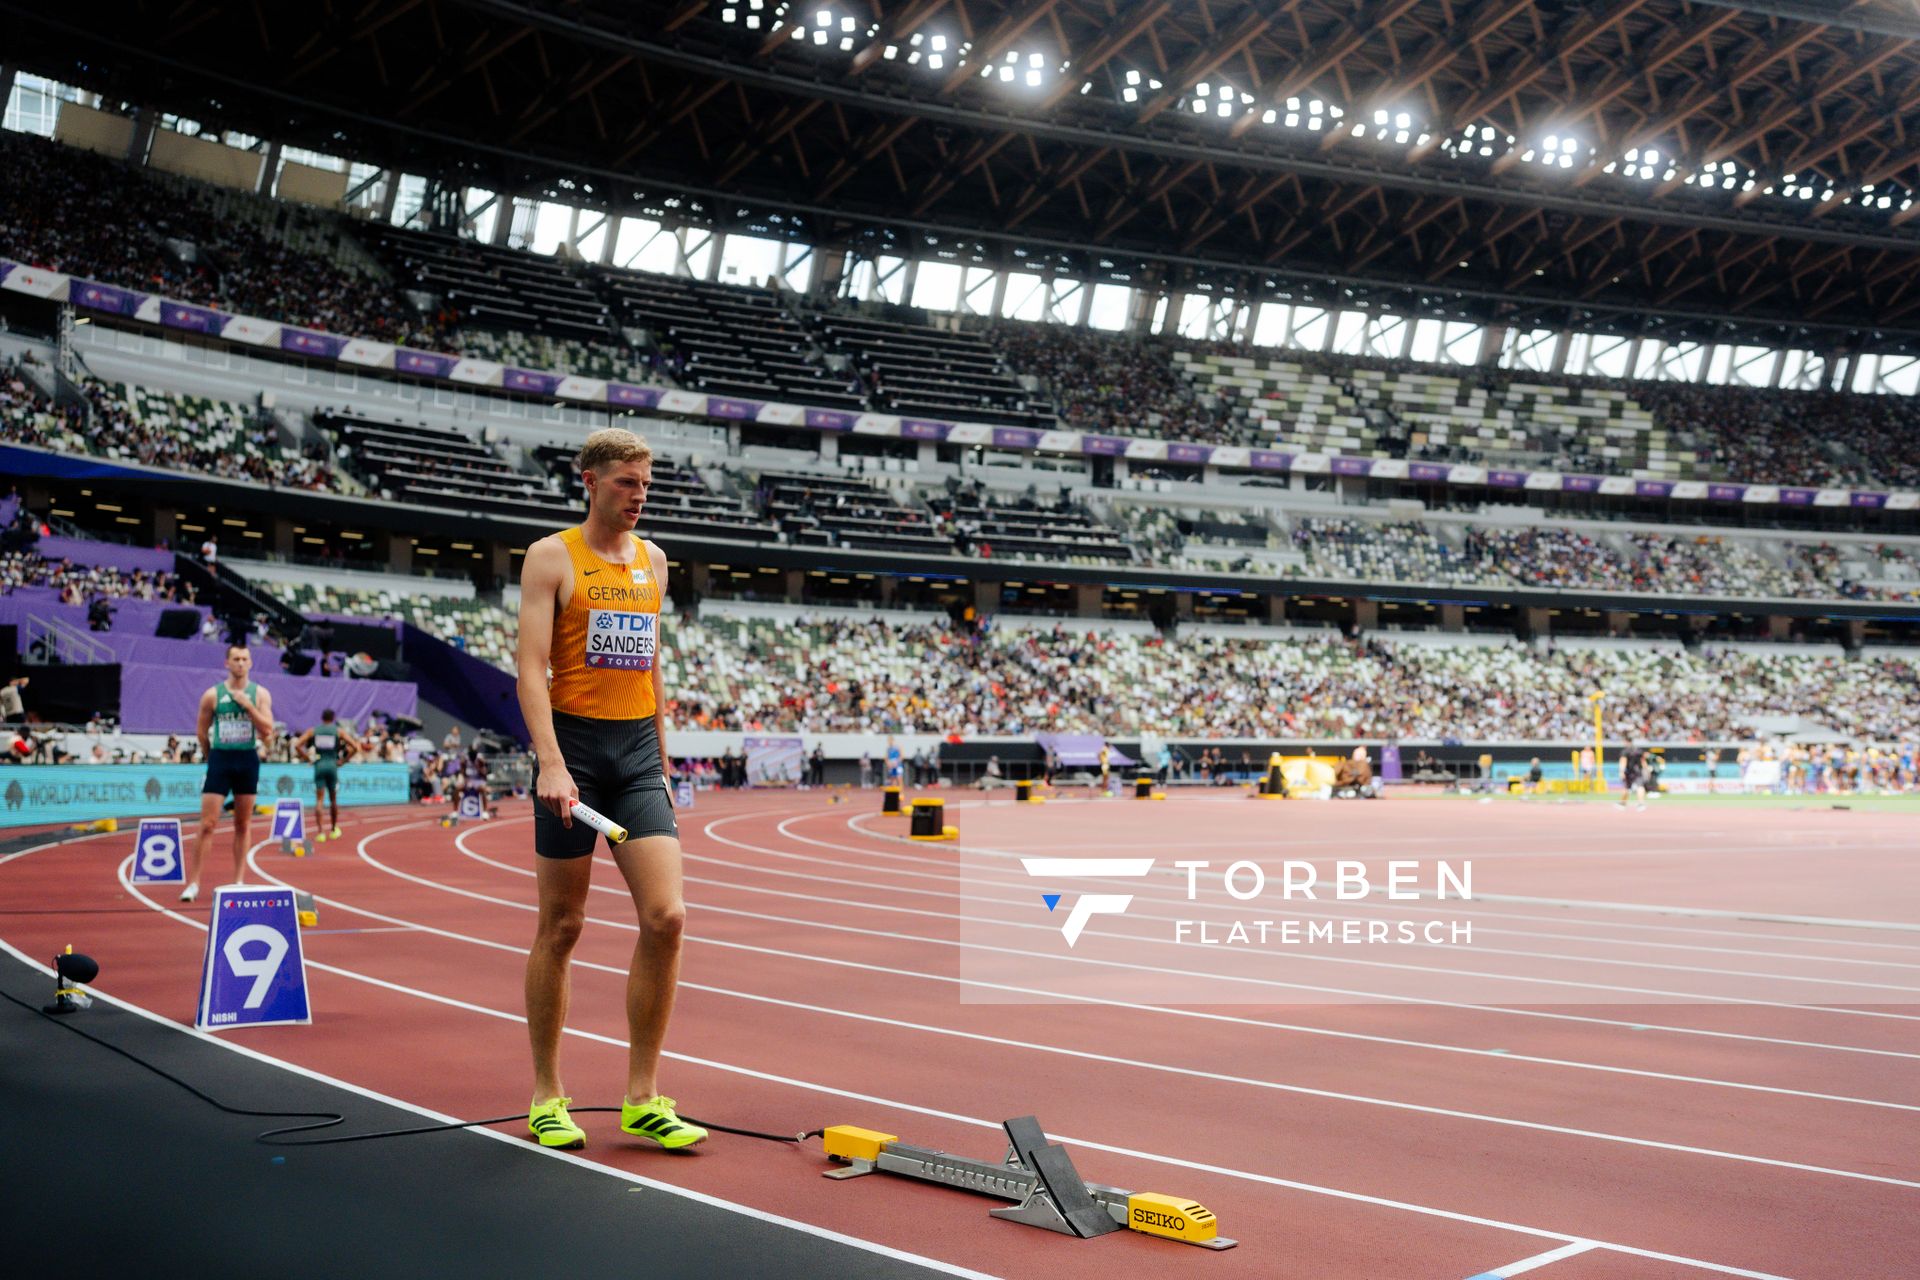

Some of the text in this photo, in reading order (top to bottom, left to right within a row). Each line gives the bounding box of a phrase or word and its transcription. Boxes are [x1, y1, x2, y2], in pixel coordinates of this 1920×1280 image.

[613, 613, 654, 632] TDK
[592, 634, 654, 654] SANDERS
[30, 781, 136, 806] WORLD ATHLETICS
[463, 796, 479, 816] 6
[278, 810, 299, 838] 7
[141, 834, 176, 876] 8
[223, 924, 289, 1009] 9
[212, 1012, 237, 1023] NISHI
[1133, 1208, 1185, 1230] SEIKO
